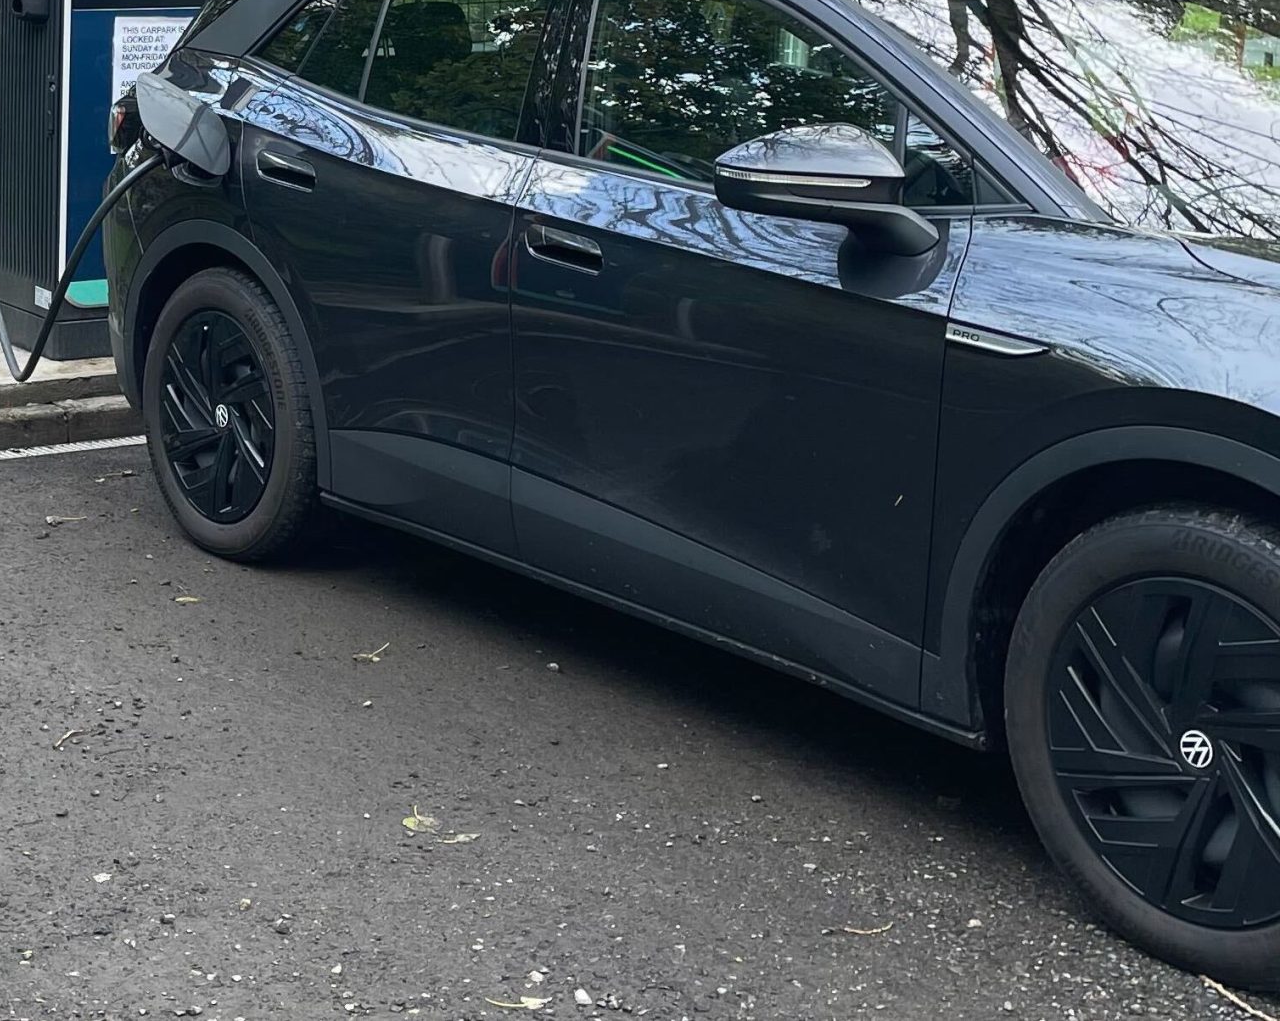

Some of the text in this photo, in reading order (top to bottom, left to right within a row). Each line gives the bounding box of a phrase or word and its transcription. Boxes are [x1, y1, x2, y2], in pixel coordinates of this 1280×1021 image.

[141, 26, 177, 34] CARPARK
[122, 44, 152, 52] SUNDAY
[952, 329, 980, 341] PRO
